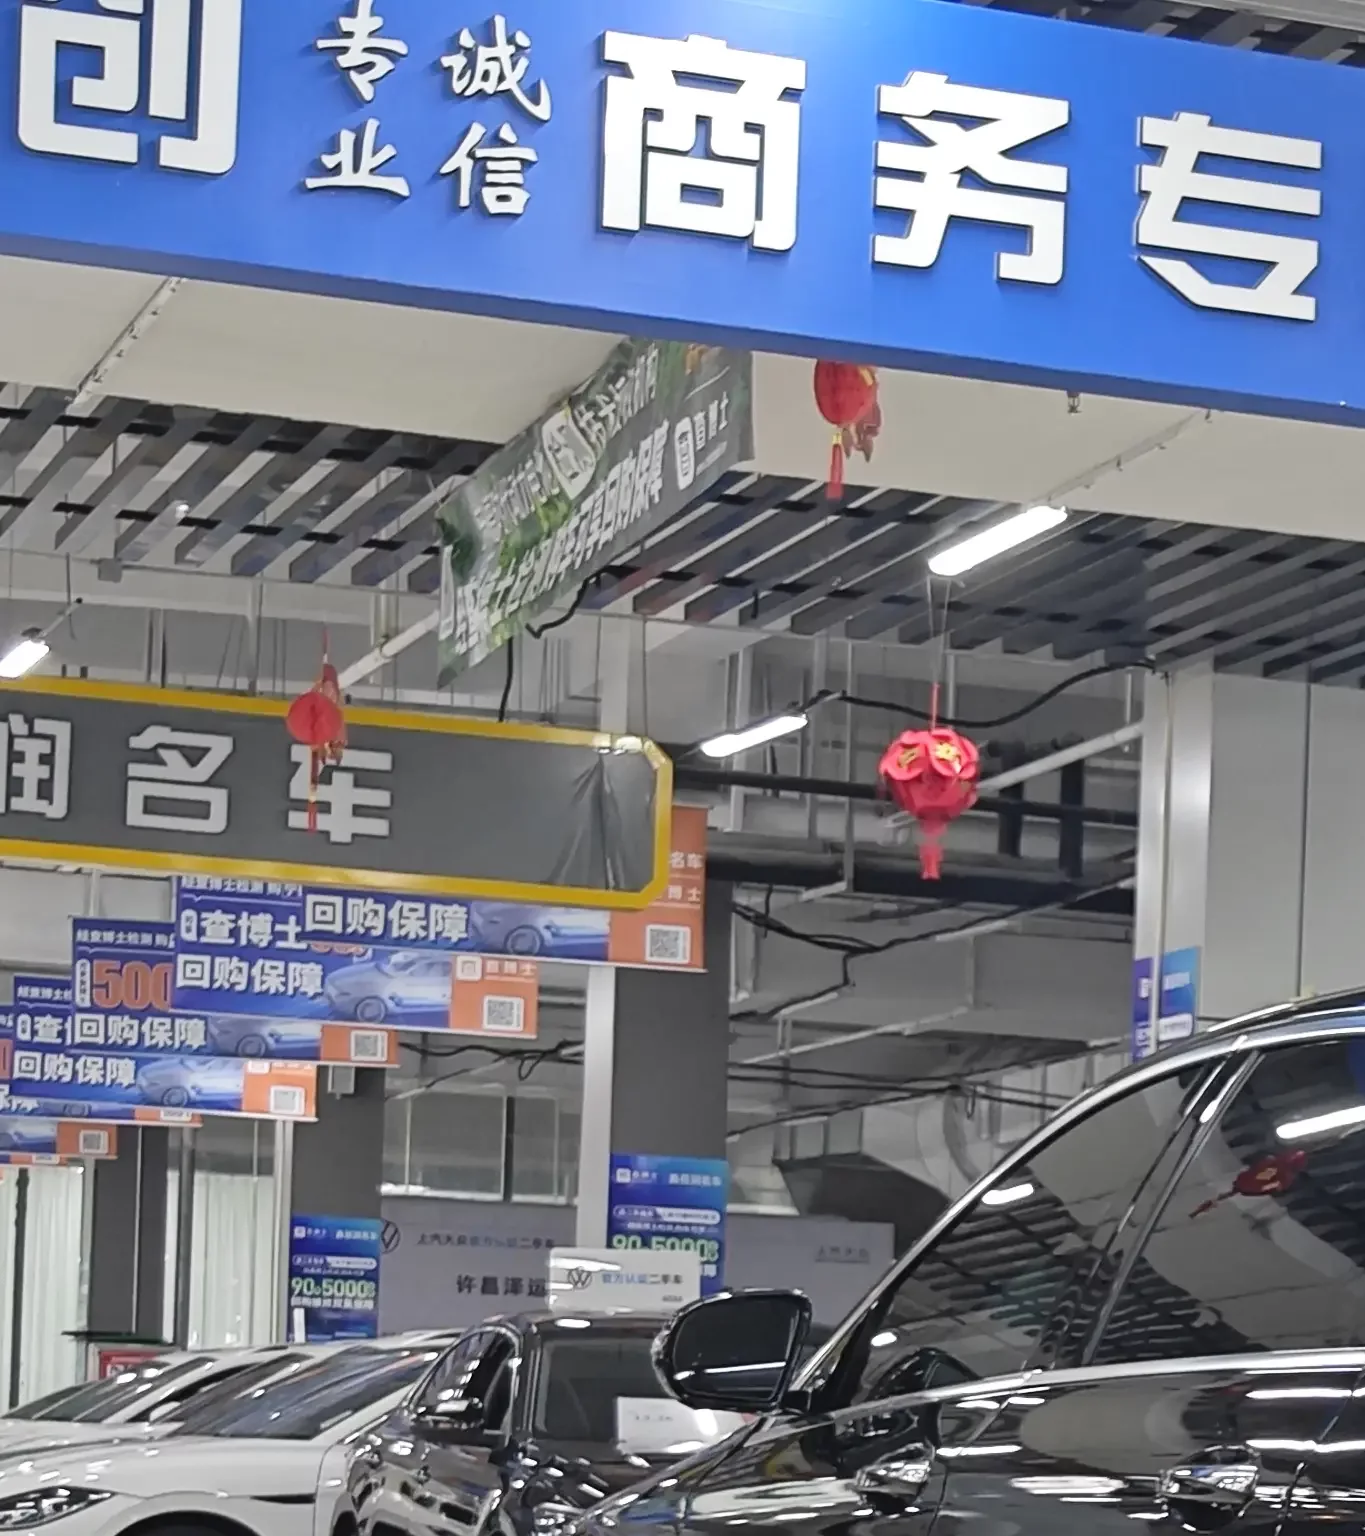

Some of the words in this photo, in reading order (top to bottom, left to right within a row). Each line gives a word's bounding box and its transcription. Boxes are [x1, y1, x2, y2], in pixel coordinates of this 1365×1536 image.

[0, 712, 393, 845] 润名车
[200, 909, 309, 950] 查博士
[304, 893, 470, 944] 回购保障
[176, 953, 324, 998] 回购保障
[75, 1012, 207, 1051] 回购保障
[12, 1050, 138, 1089] 回购保障
